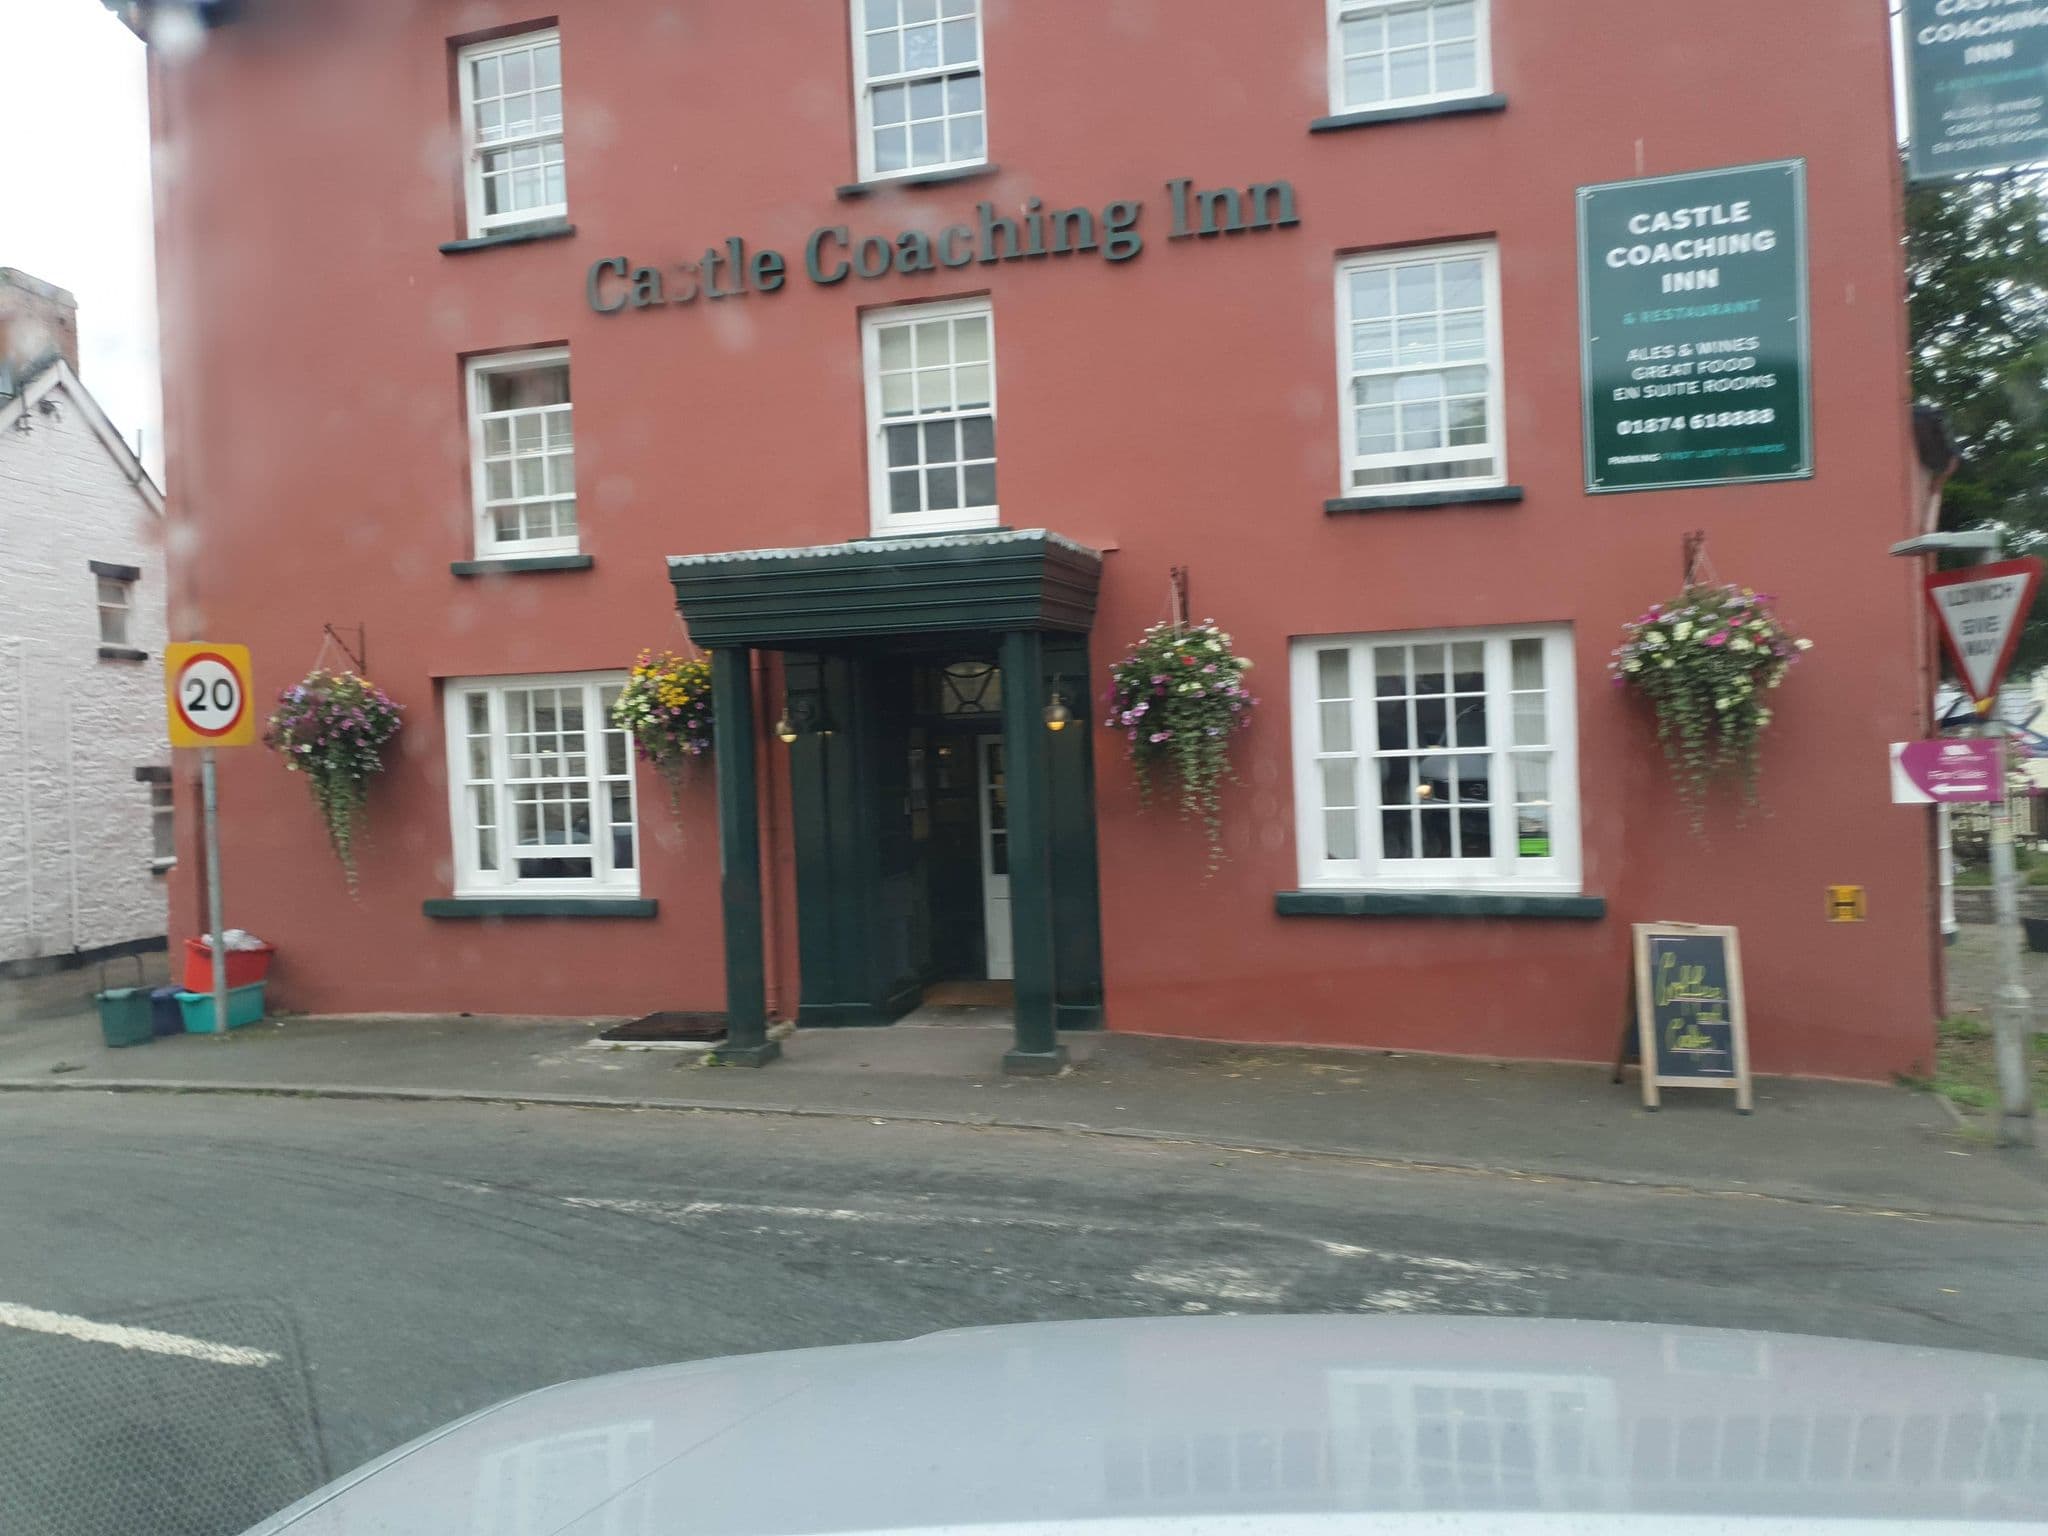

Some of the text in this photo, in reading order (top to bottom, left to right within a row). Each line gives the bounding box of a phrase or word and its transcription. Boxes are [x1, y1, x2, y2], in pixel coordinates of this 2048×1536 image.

[1628, 201, 1752, 235] CASTLE
[586, 176, 1302, 316] Castle Coaching Inn
[1606, 229, 1777, 268] COACHING
[1662, 267, 1720, 294] INN
[1626, 344, 1676, 362] ALES
[1696, 336, 1761, 355] WINES
[1631, 356, 1756, 381] GREAT FOOD
[1612, 373, 1777, 401] EN SUITE ROOMS
[186, 678, 234, 712] 20
